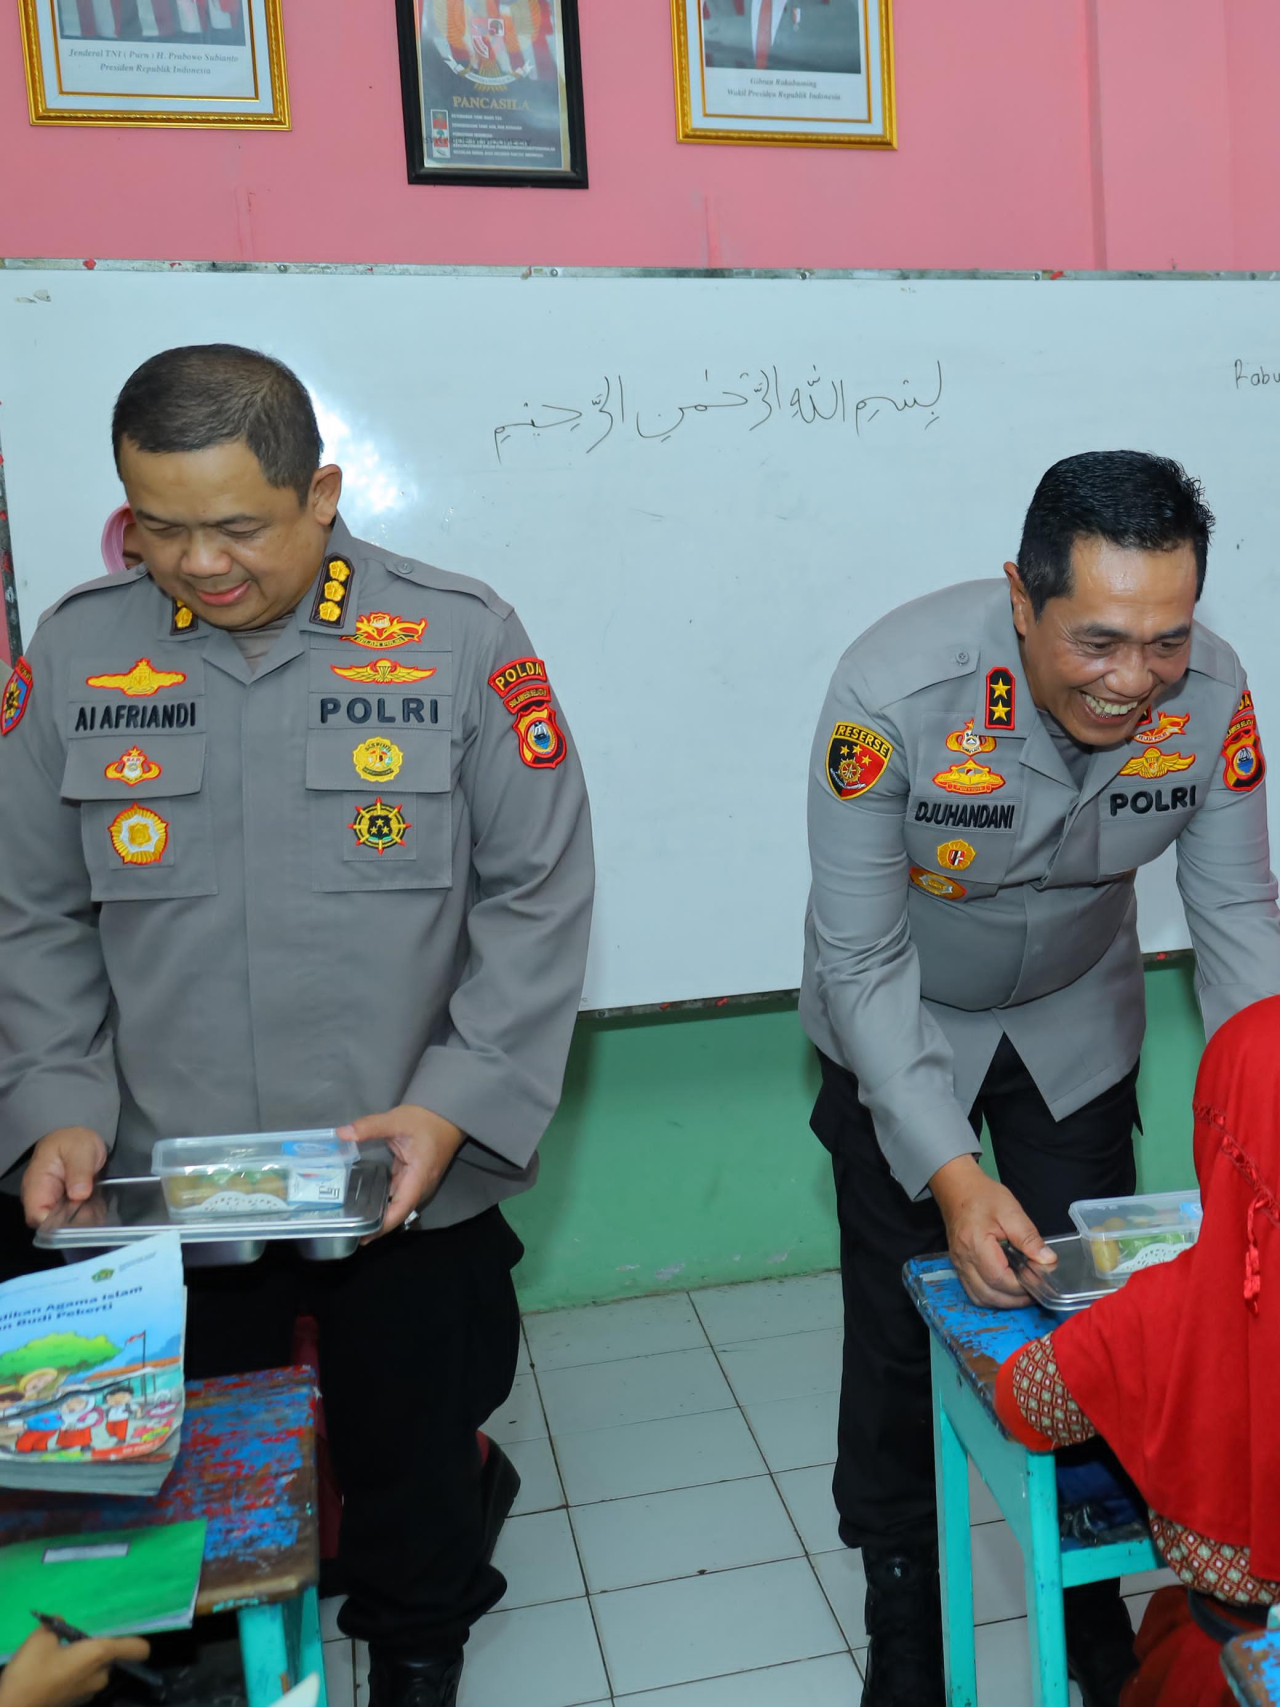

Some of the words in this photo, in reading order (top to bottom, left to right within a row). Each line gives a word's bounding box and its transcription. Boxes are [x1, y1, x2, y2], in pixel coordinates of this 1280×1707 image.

[100, 63, 133, 72] Presiden
[136, 64, 171, 74] Republik
[173, 65, 211, 74] Indonesia
[106, 50, 121, 58] TNI
[168, 52, 202, 61] Prabowo
[204, 54, 238, 62] Subianto
[452, 96, 530, 110] PANCASILA
[495, 661, 543, 691] POLDA
[75, 706, 96, 732] AI
[100, 701, 196, 730] AFRIANDI
[320, 697, 438, 724] POLRI
[837, 725, 888, 756] RESERSE
[1109, 785, 1197, 817] POLRI
[914, 801, 1015, 829] DJUHANDANI
[46, 1297, 98, 1312] Agama
[102, 1285, 143, 1300] Islam
[16, 1314, 52, 1328] Budi
